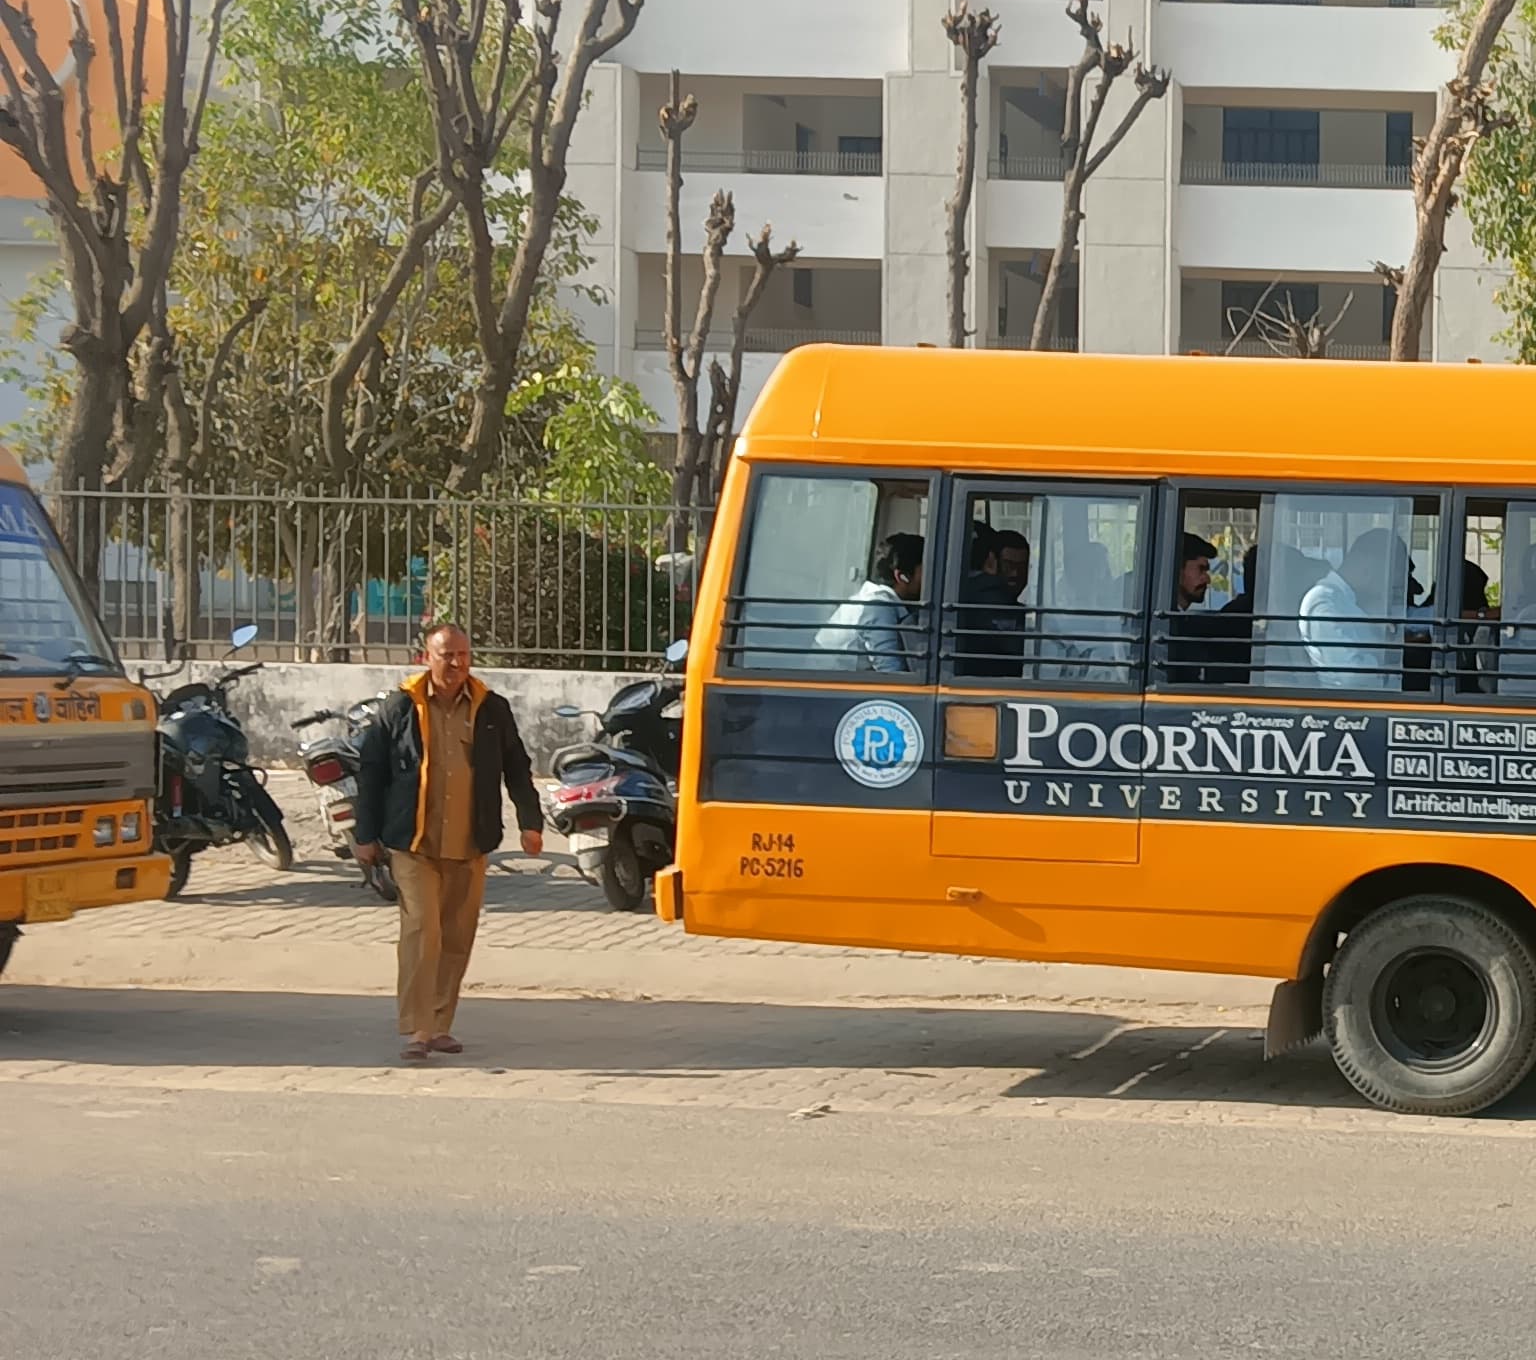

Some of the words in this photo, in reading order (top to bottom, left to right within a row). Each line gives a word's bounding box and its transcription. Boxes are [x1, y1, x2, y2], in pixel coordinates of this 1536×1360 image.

[1230, 712, 1295, 729] Dreams
[1333, 716, 1370, 731] Goal
[1003, 702, 1375, 778] POORNIMA
[1394, 724, 1443, 742] B.Tech
[1393, 757, 1429, 775] BVA
[1443, 760, 1489, 778] B.Voc
[1003, 780, 1373, 818] UNIVERSITY
[1394, 793, 1465, 814] Artificial
